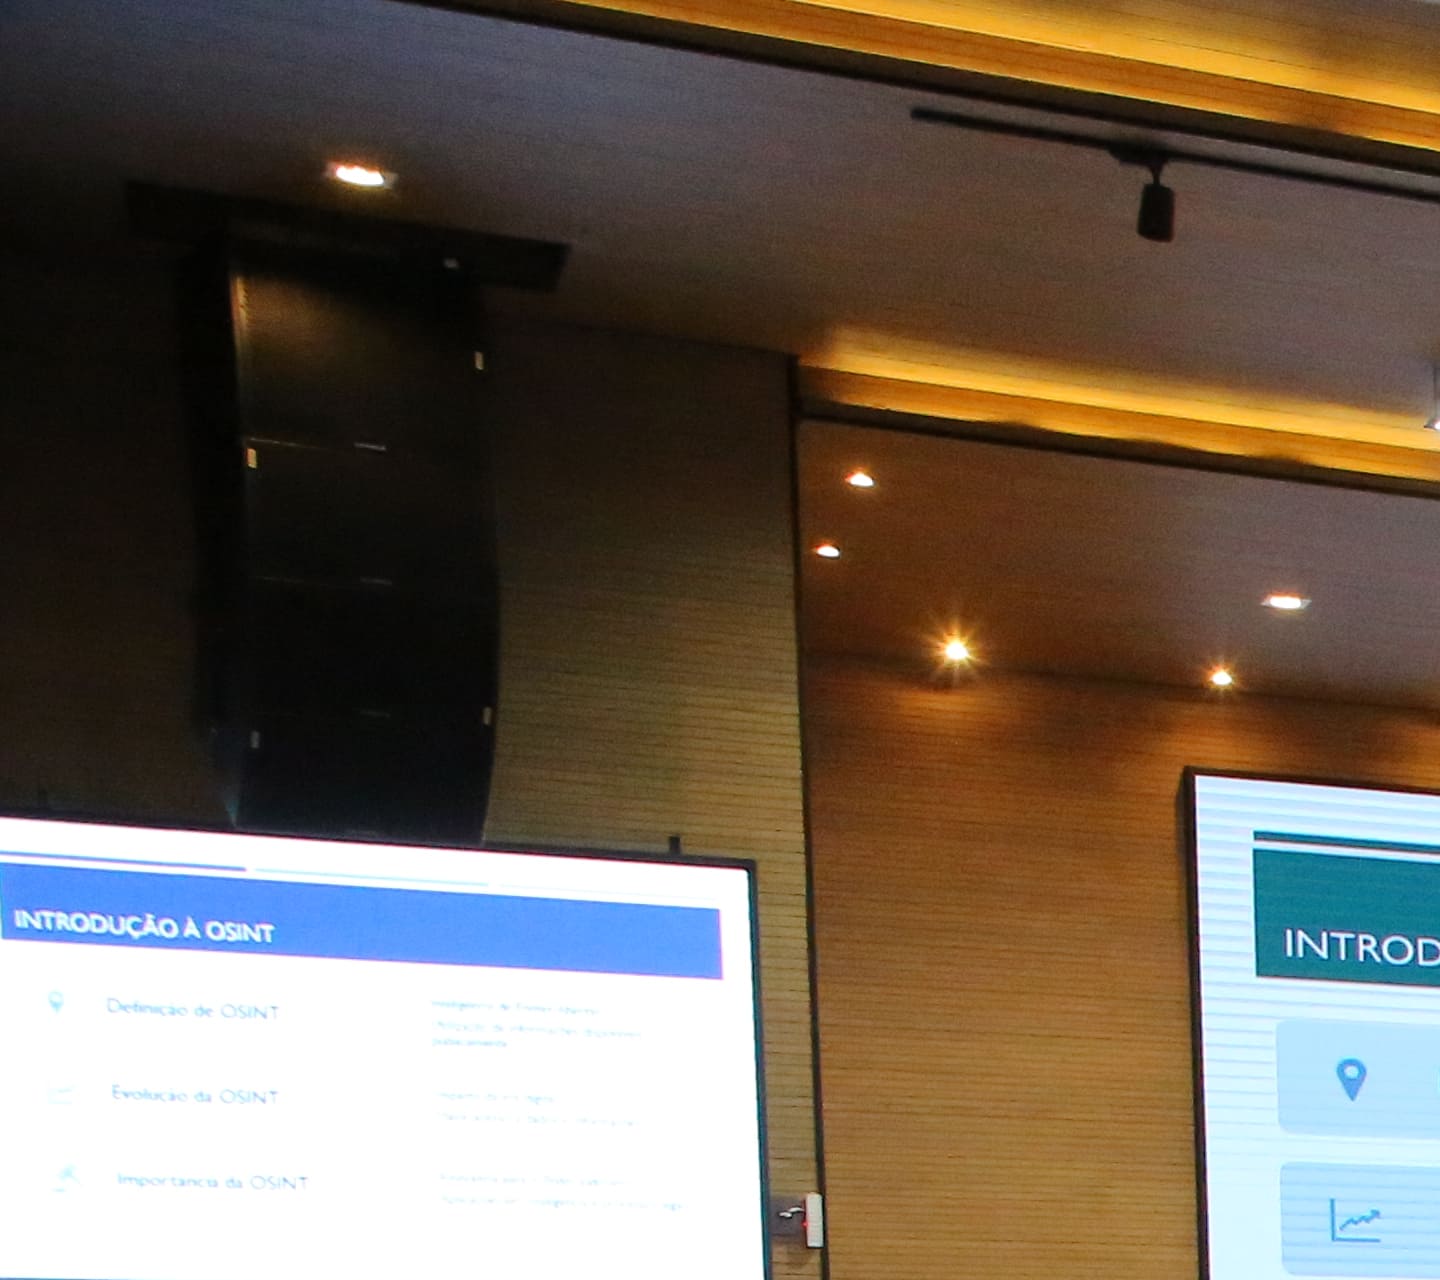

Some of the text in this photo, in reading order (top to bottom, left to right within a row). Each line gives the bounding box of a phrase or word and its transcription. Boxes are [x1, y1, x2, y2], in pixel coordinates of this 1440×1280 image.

[14, 908, 276, 943] INTRODUÇÃO À OSINT
[220, 1003, 279, 1020] OSINT
[219, 1088, 279, 1105] OSINT
[249, 1175, 309, 1191] OSINT
